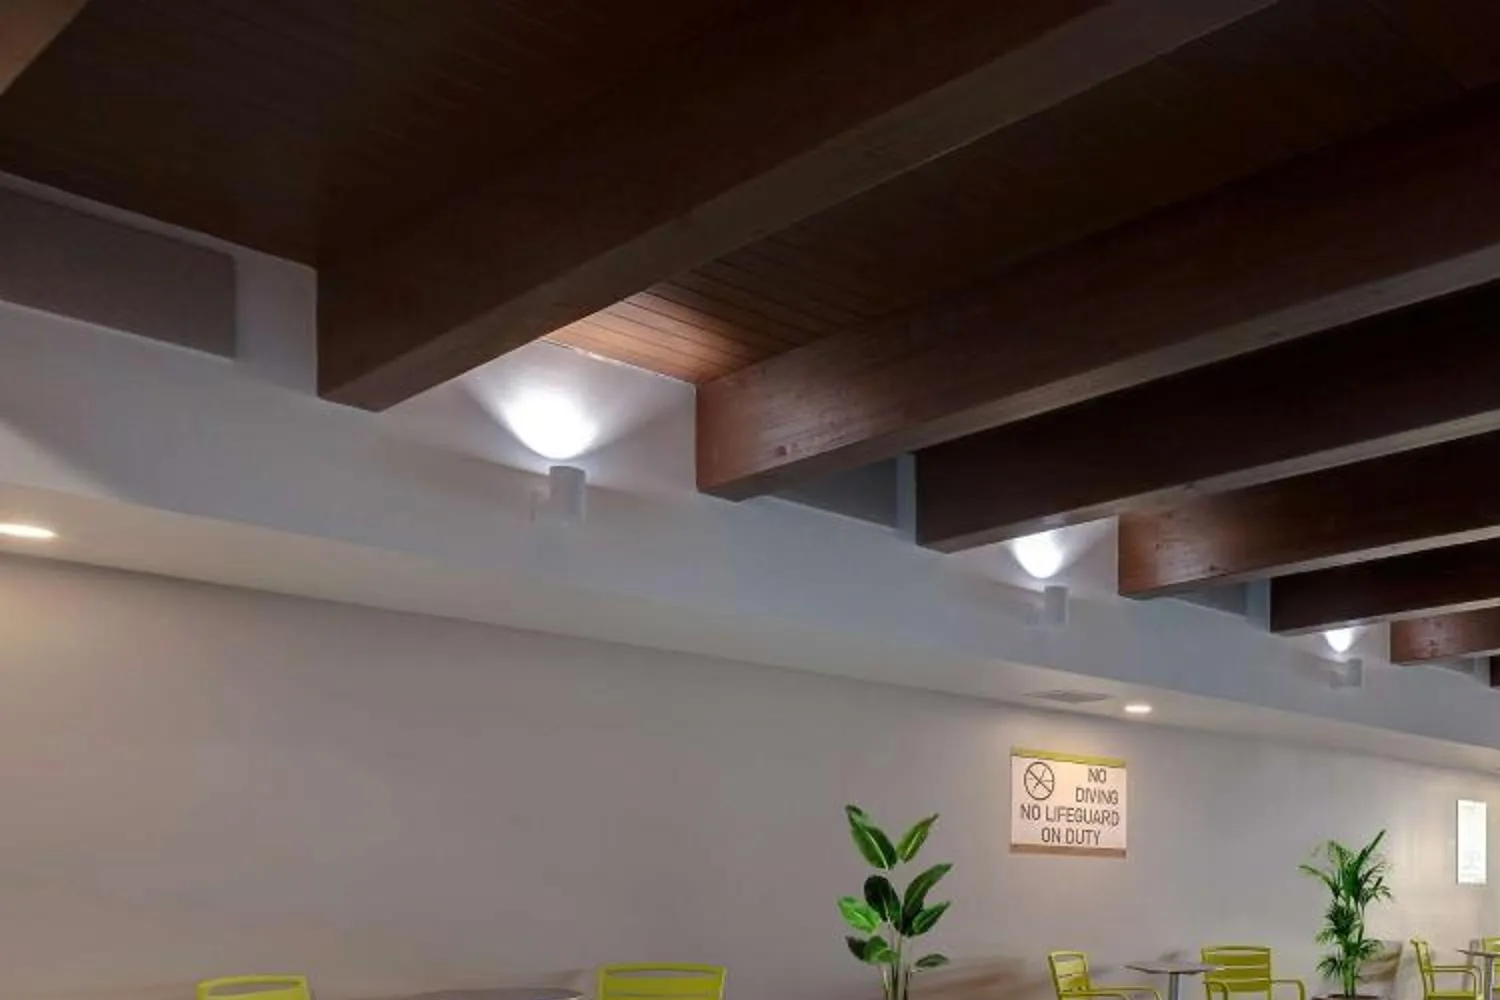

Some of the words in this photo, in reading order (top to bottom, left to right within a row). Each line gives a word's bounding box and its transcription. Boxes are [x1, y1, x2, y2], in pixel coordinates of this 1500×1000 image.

[1088, 768, 1107, 783] NO
[1075, 787, 1119, 805] DIVING
[1020, 803, 1041, 821] NO
[1046, 805, 1120, 827] LIFEGUARD
[1041, 827, 1061, 843] ON
[1066, 829, 1101, 845] DUTY
